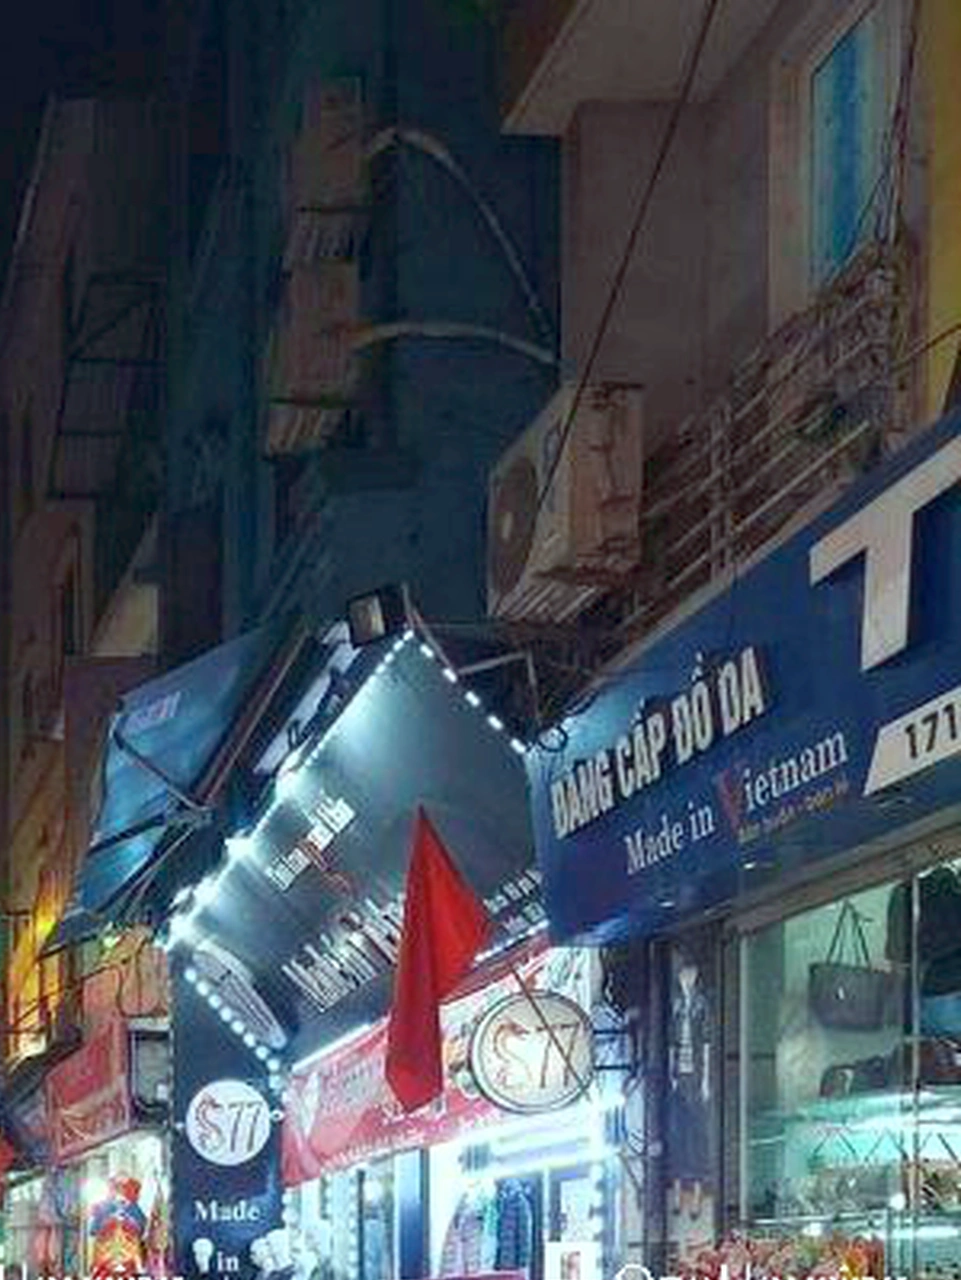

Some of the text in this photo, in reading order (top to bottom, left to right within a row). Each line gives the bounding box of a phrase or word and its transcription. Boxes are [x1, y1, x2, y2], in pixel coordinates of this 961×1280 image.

[718, 647, 765, 737] DA
[905, 702, 957, 759] 171
[623, 814, 684, 876] Made
[688, 801, 716, 842] in
[194, 1199, 261, 1222] Made
[217, 1252, 240, 1272] in
